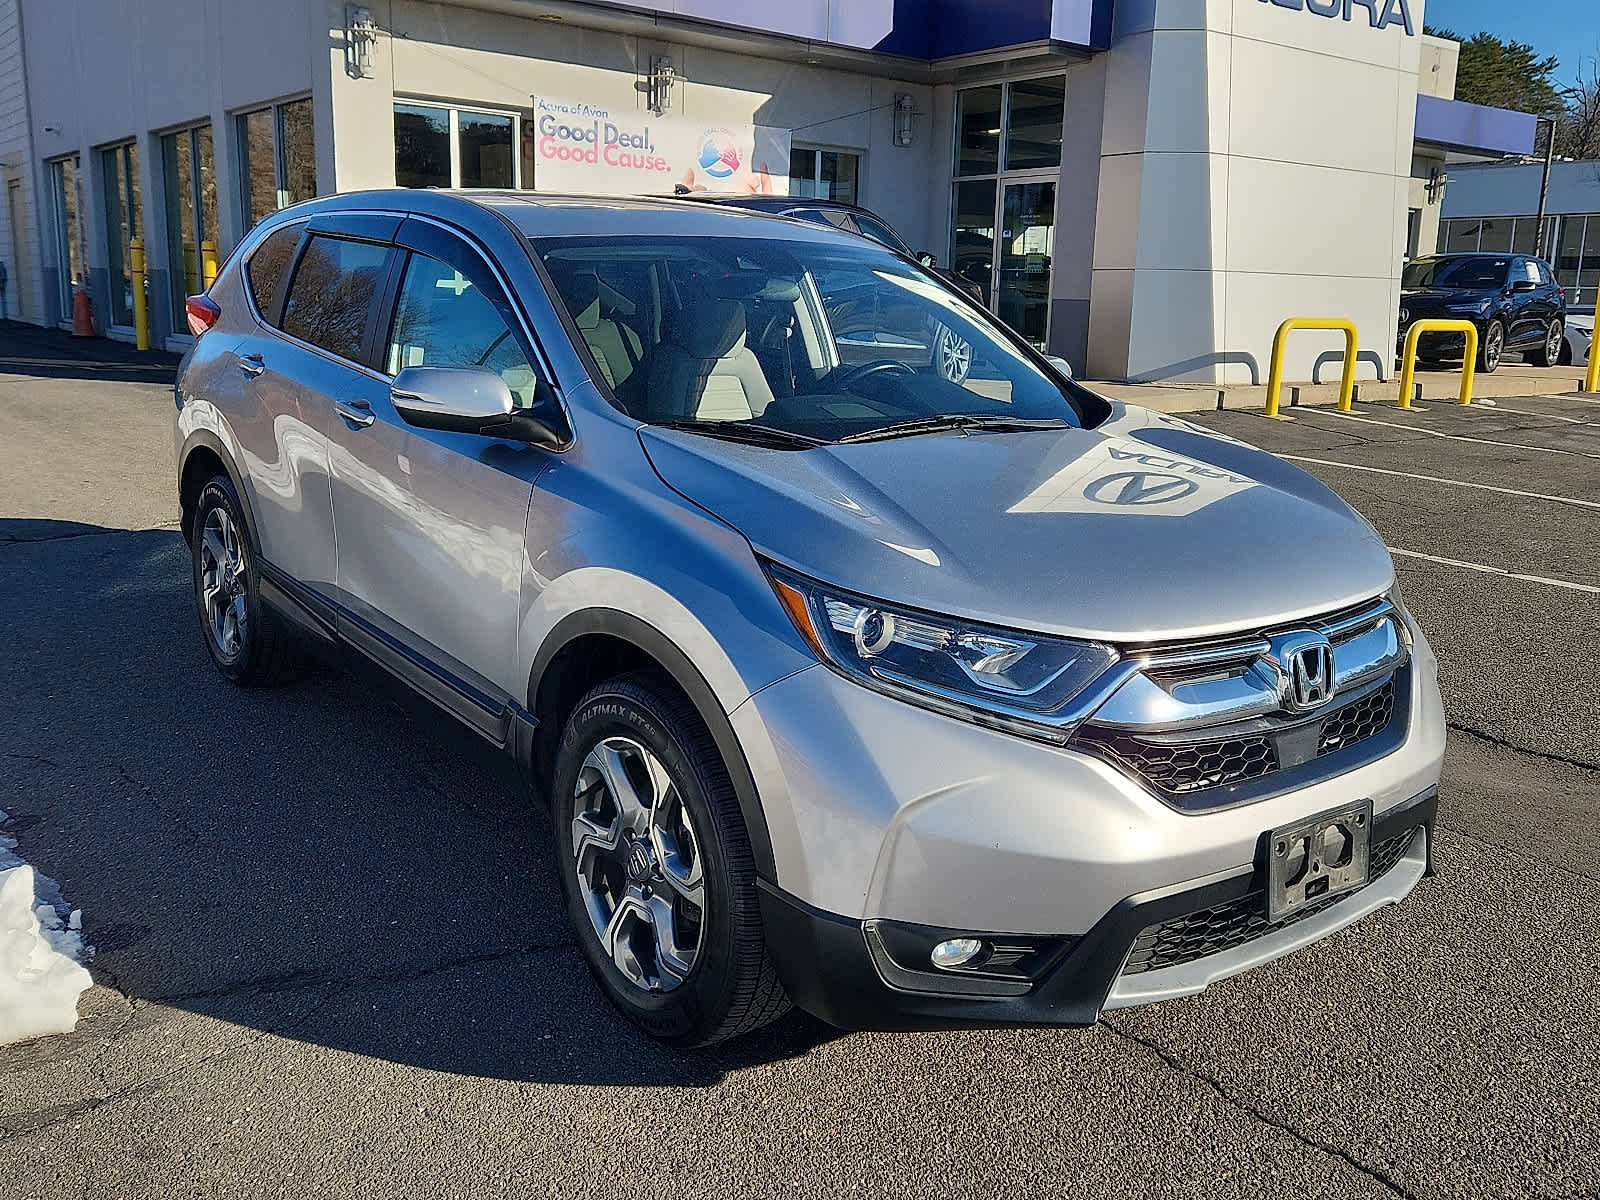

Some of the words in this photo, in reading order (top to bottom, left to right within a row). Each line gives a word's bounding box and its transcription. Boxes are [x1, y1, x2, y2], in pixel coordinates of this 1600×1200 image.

[538, 98, 568, 113] Acura
[570, 103, 581, 115] of
[583, 105, 608, 119] Avon
[539, 114, 598, 143] Good
[604, 122, 655, 153] Deal,
[539, 135, 598, 164] Good
[604, 144, 672, 173] Cause.
[581, 703, 627, 725] ALTIMAX
